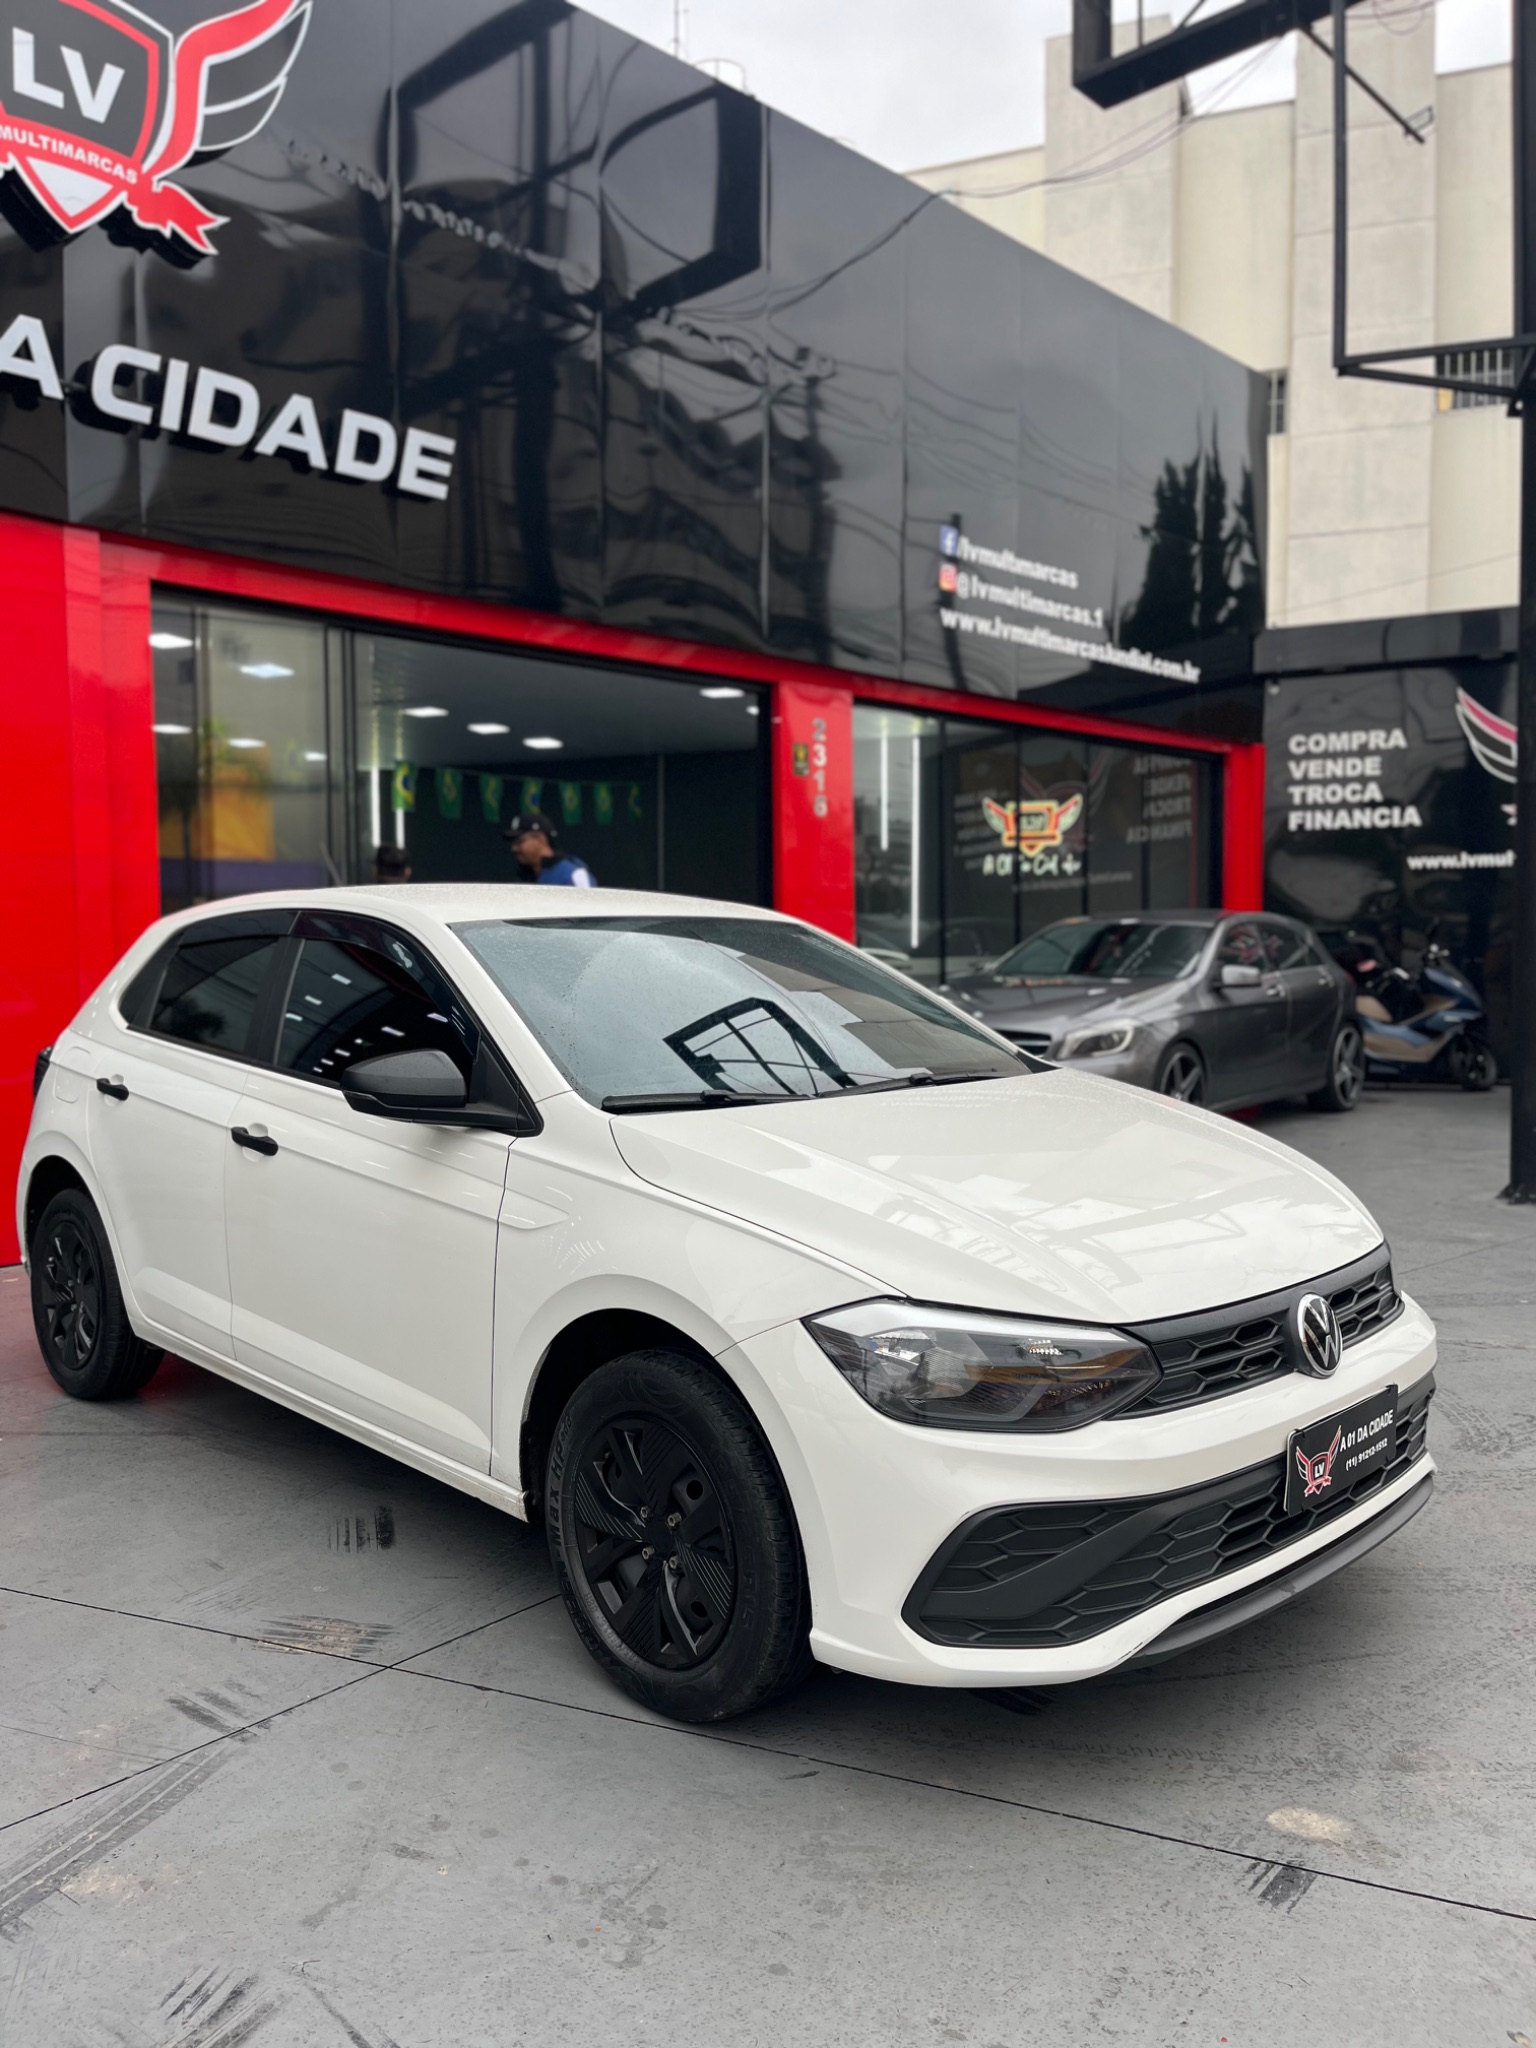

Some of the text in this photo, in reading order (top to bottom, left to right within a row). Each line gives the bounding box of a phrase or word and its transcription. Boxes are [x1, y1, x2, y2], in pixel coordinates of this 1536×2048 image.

[12, 26, 125, 124] LV
[0, 125, 138, 185] MULTIMARCAS
[91, 344, 457, 500] CIDADE
[1288, 728, 1408, 755] COMPRA
[1288, 756, 1383, 780] VENDE
[1288, 781, 1384, 805] TROCA
[1288, 805, 1423, 832] FINANCIA
[1406, 849, 1517, 871] www.lvmul
[1340, 1409, 1394, 1453] A 01 DA CIDADE
[1314, 1461, 1325, 1478] LV
